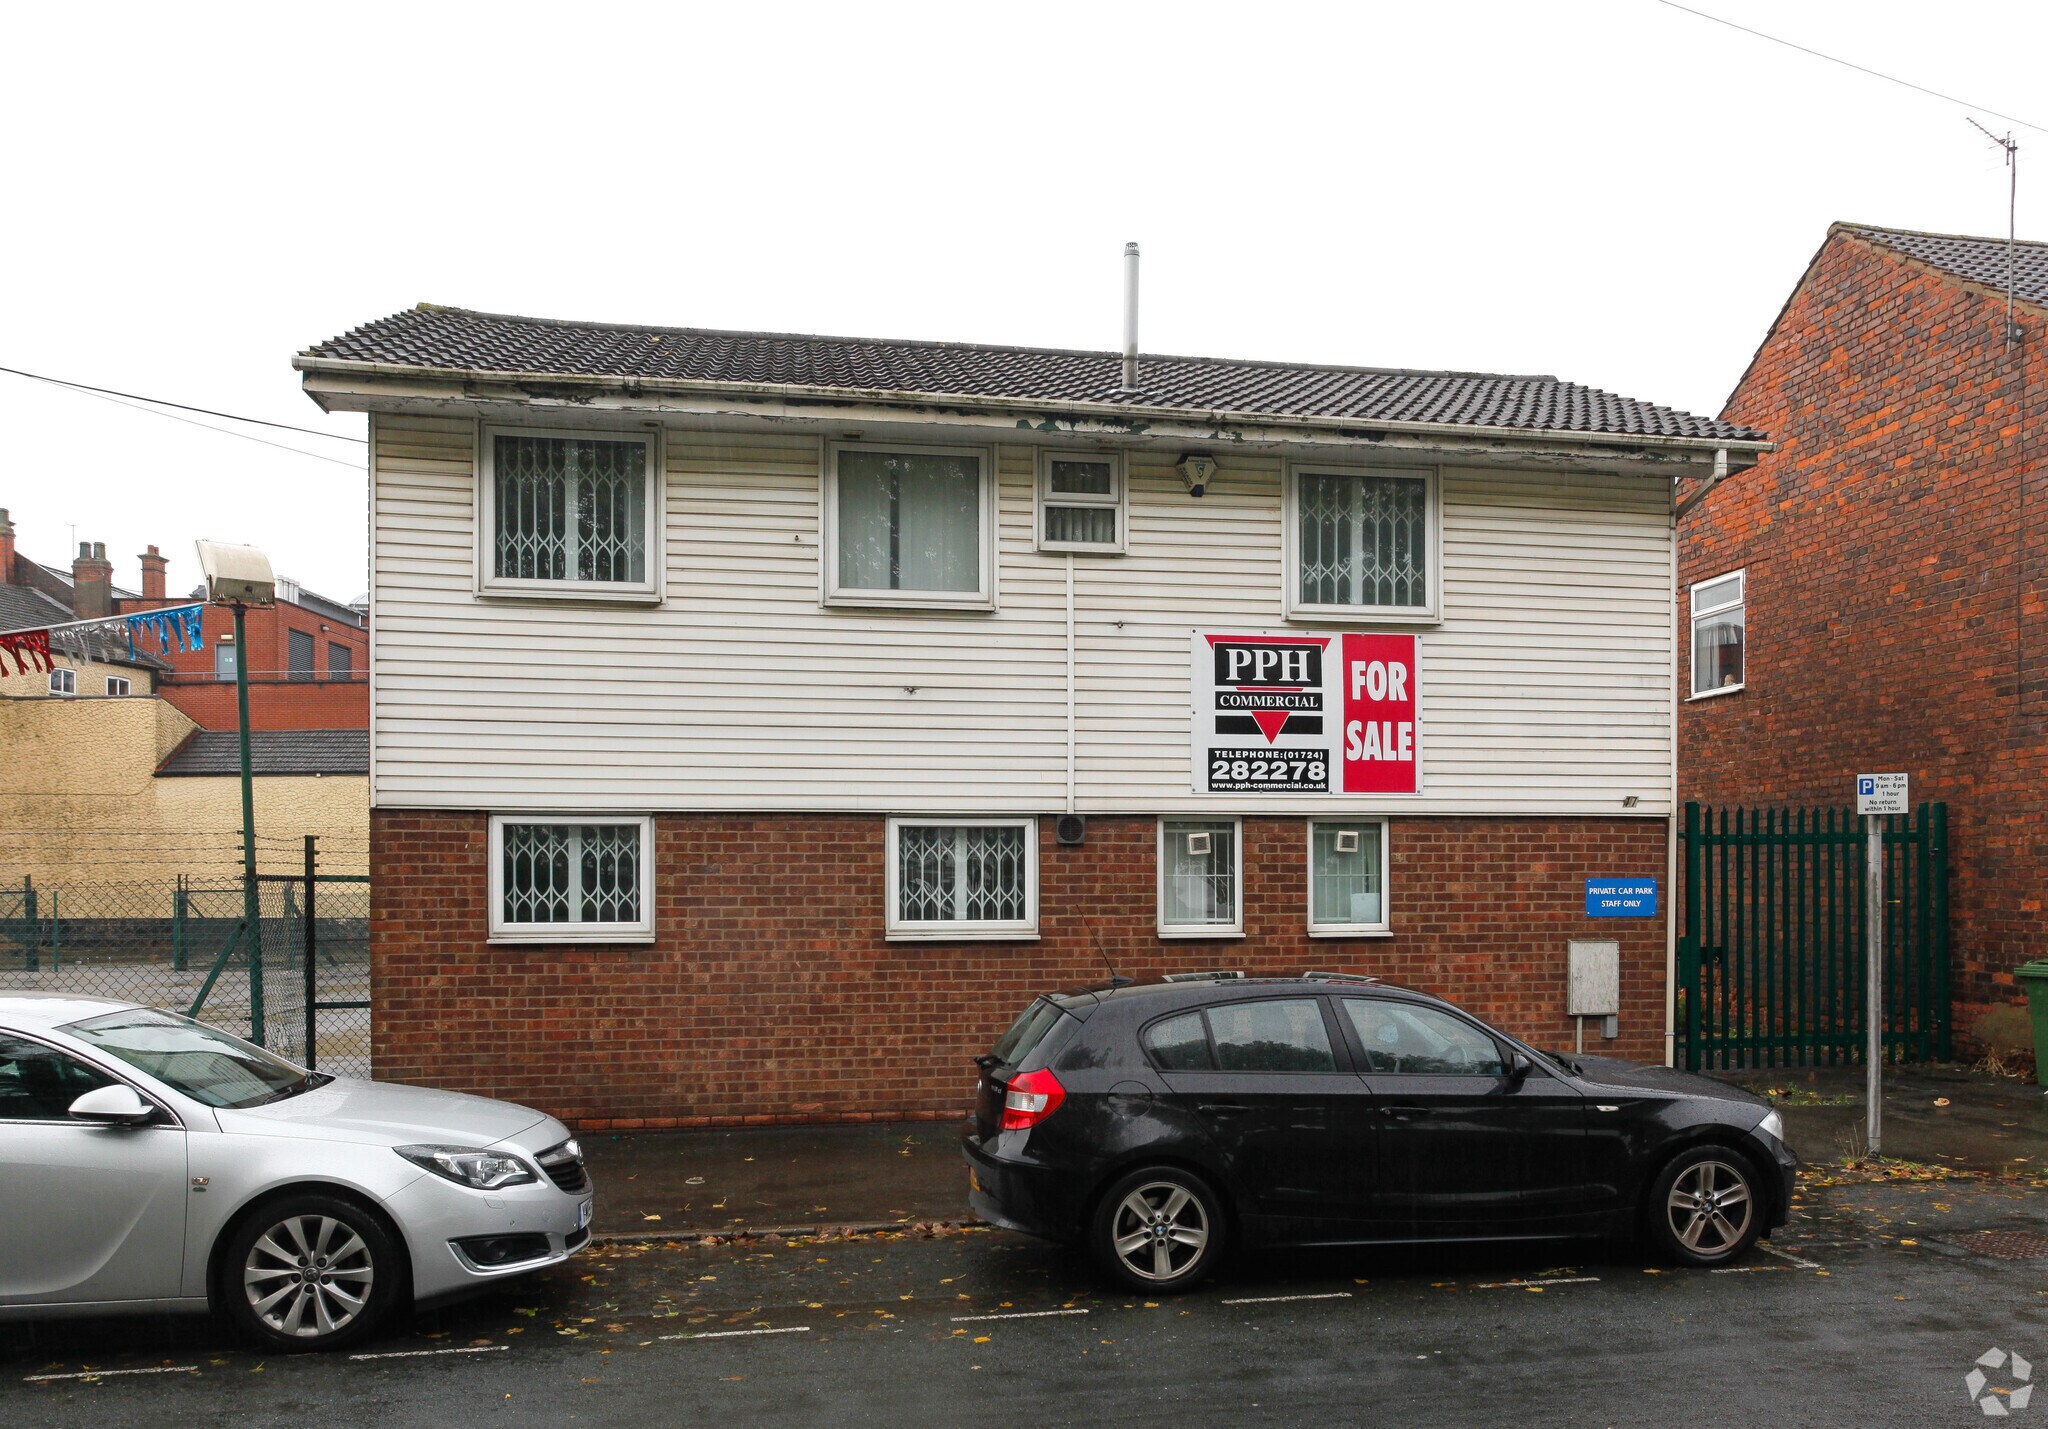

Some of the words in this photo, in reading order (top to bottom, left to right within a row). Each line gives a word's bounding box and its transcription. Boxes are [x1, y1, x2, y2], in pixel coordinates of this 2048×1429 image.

[1225, 648, 1311, 682] PPH
[1351, 660, 1408, 701] FOR
[1219, 695, 1318, 708] COMMERCIAL
[1346, 720, 1412, 761] SALE
[1211, 760, 1326, 780] 282278
[1211, 782, 1326, 790] www.pph-commercial.co.uk
[1862, 780, 1872, 794] P
